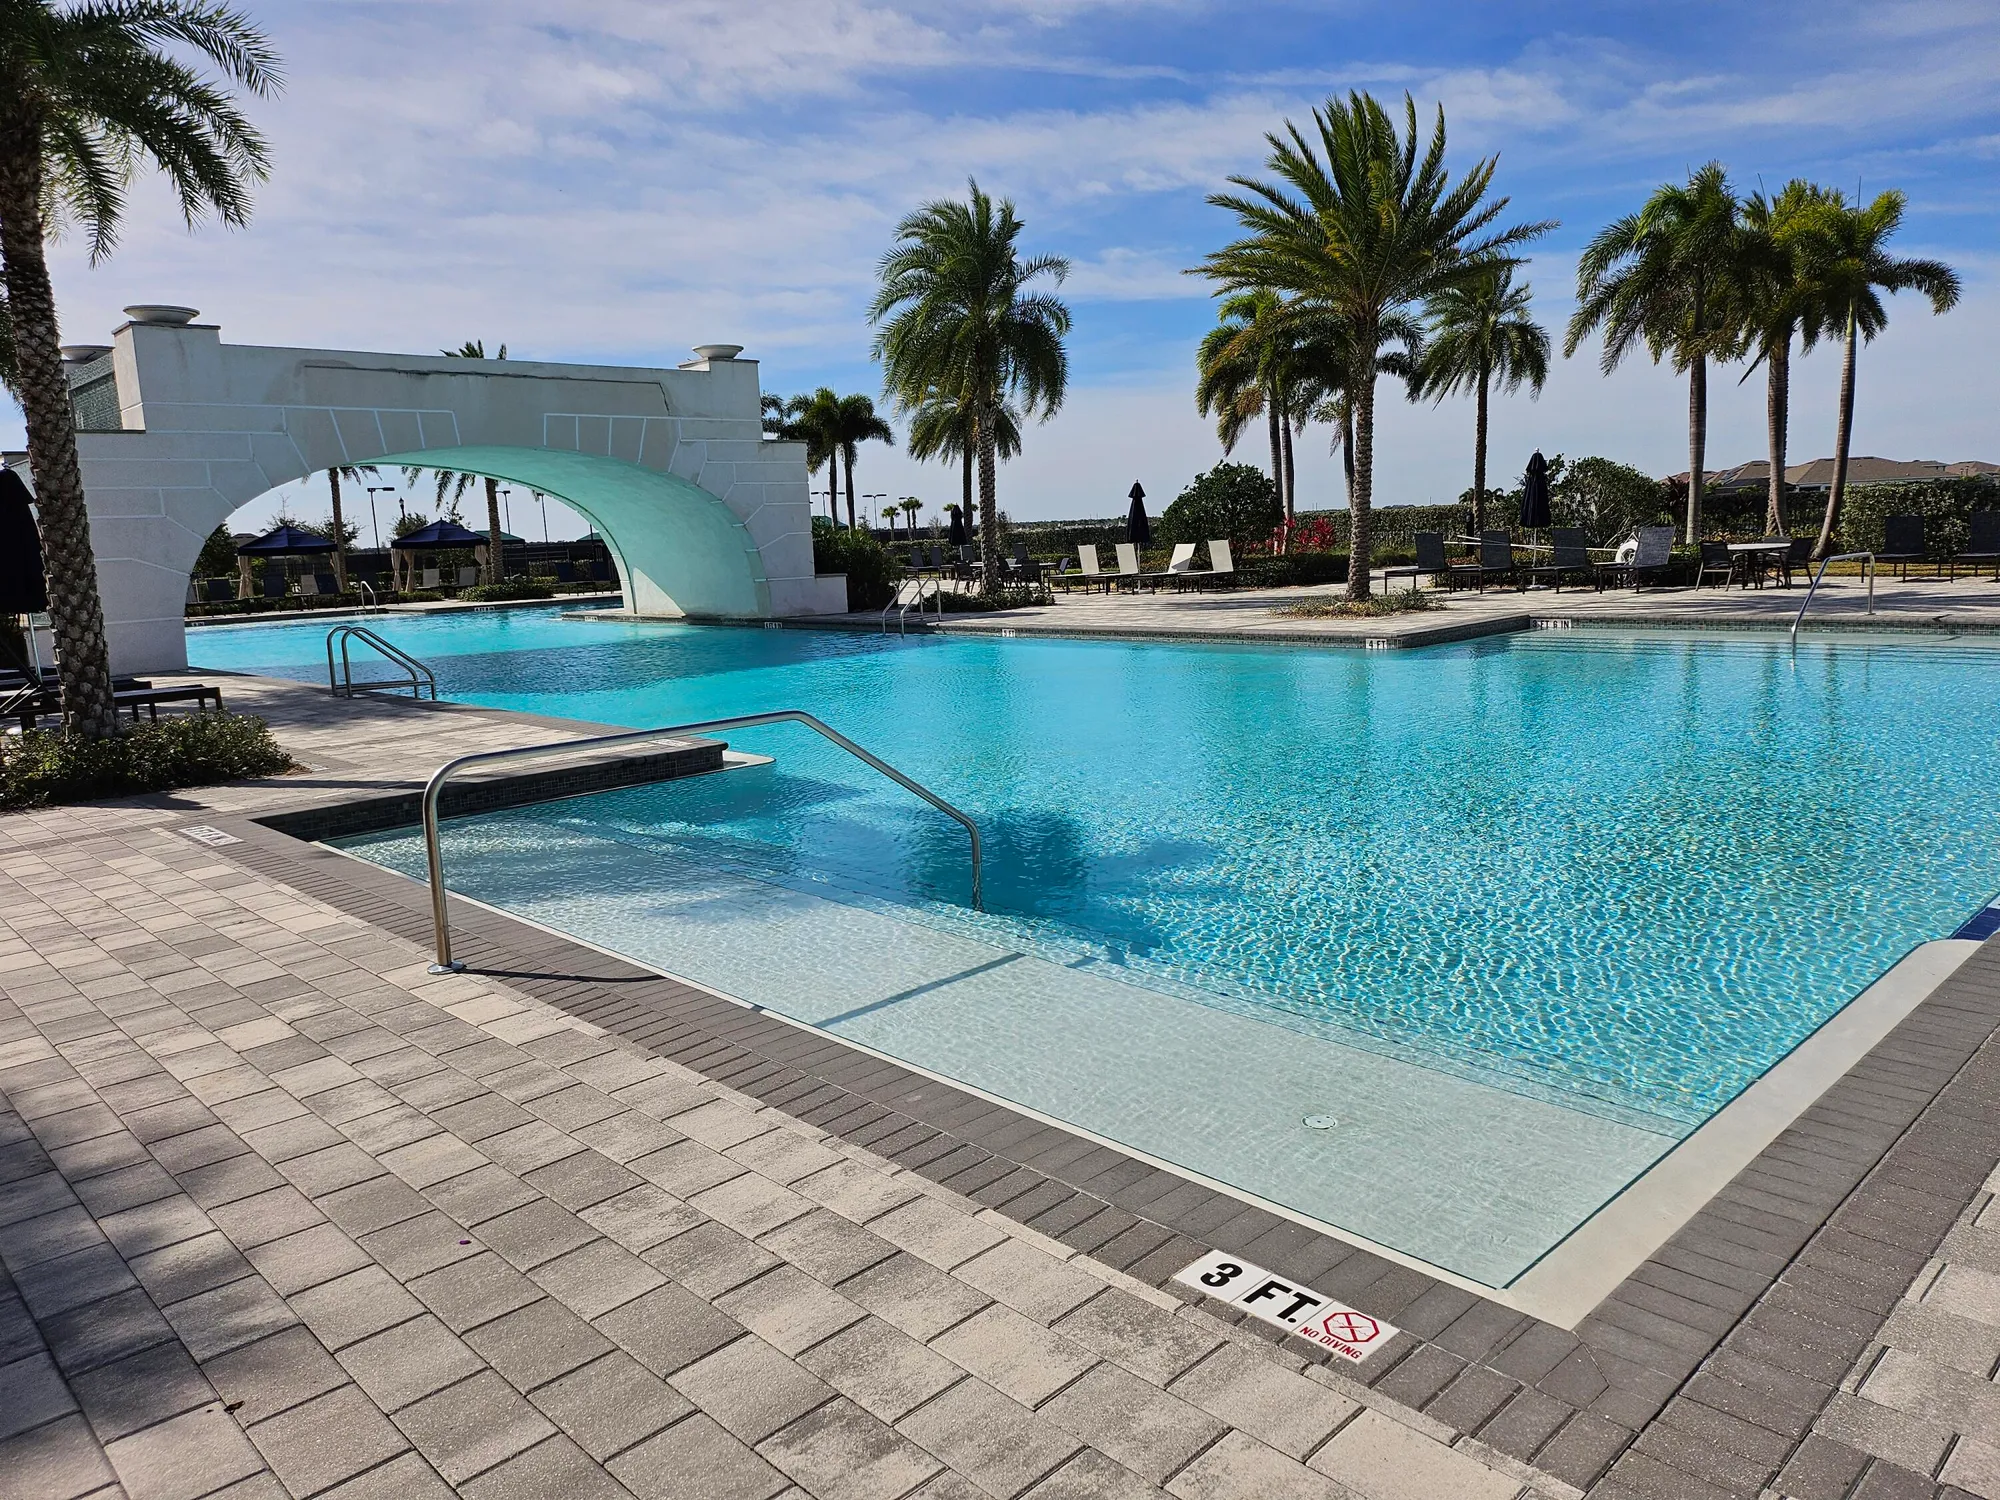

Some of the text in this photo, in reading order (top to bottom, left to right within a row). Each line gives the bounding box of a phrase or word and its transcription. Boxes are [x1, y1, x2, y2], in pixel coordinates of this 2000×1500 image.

[1533, 620, 1537, 628] 3
[1540, 620, 1550, 629] FT
[1369, 640, 1386, 649] 4 FT
[1200, 1262, 1243, 1288] 3
[1299, 1326, 1363, 1360] NO DIVING
